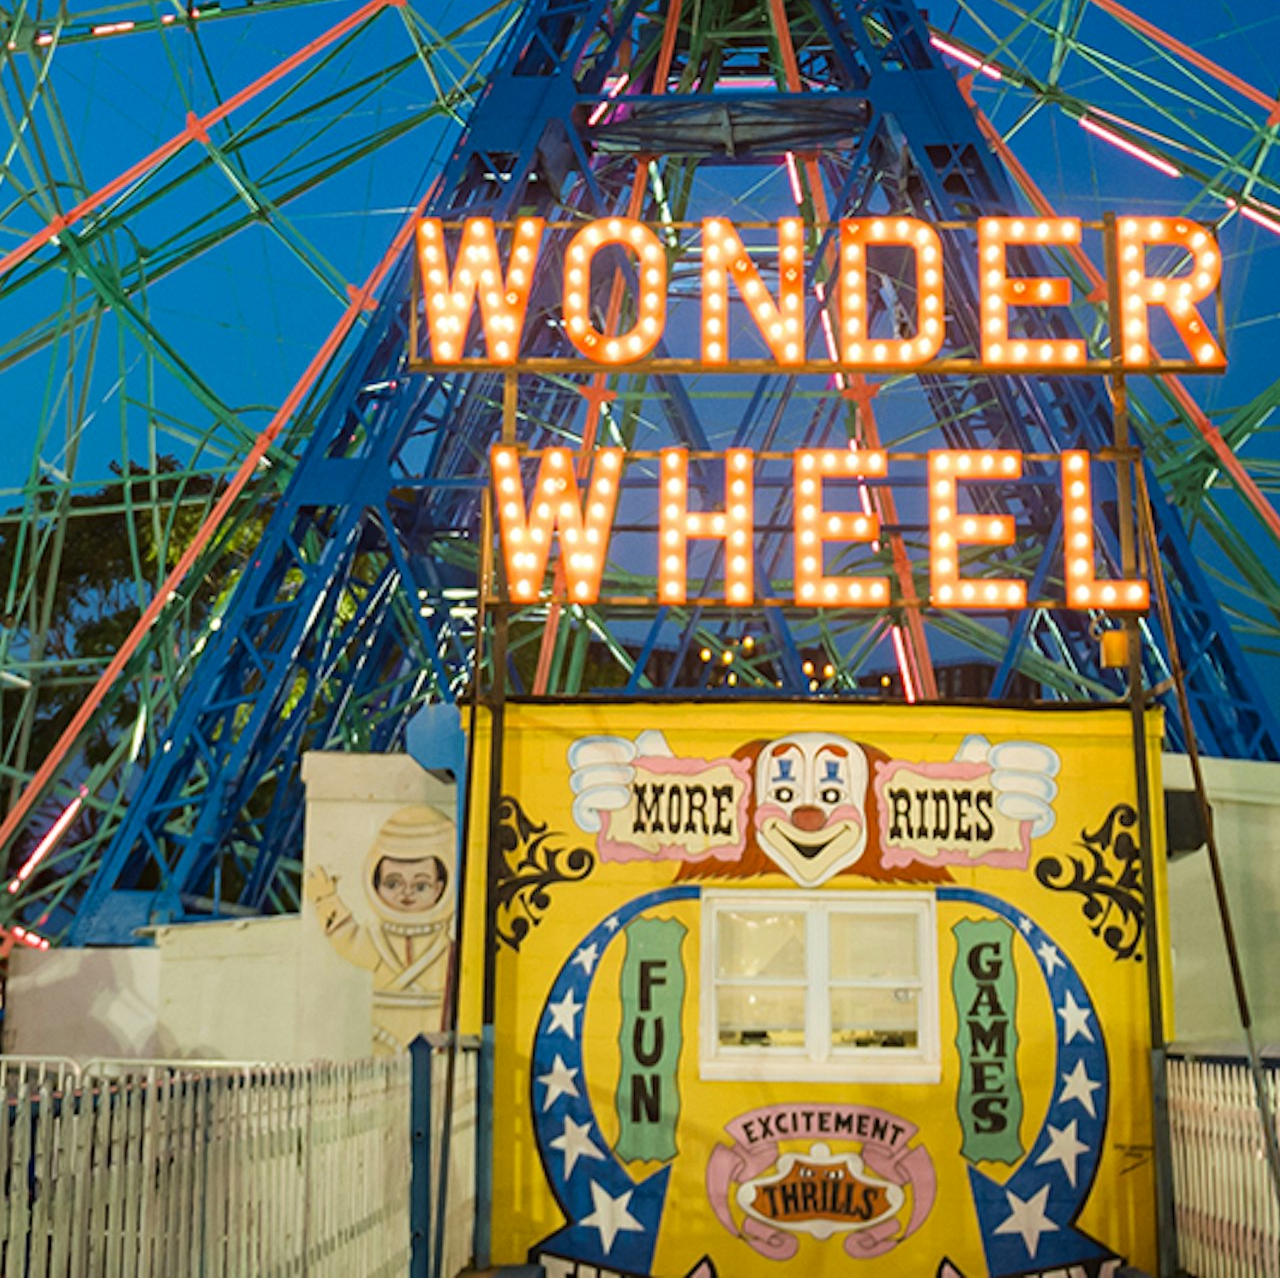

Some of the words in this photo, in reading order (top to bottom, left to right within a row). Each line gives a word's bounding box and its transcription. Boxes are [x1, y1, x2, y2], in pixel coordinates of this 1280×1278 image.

[415, 215, 1227, 368] WONDER
[492, 445, 1150, 609] WHEEL
[632, 782, 734, 838] MORE
[888, 787, 994, 843] RIDES
[630, 958, 669, 1125] FUN
[966, 941, 1010, 1136] GAMES
[742, 1111, 906, 1146] EXCITEMENT
[762, 1178, 879, 1221] THRILLS
